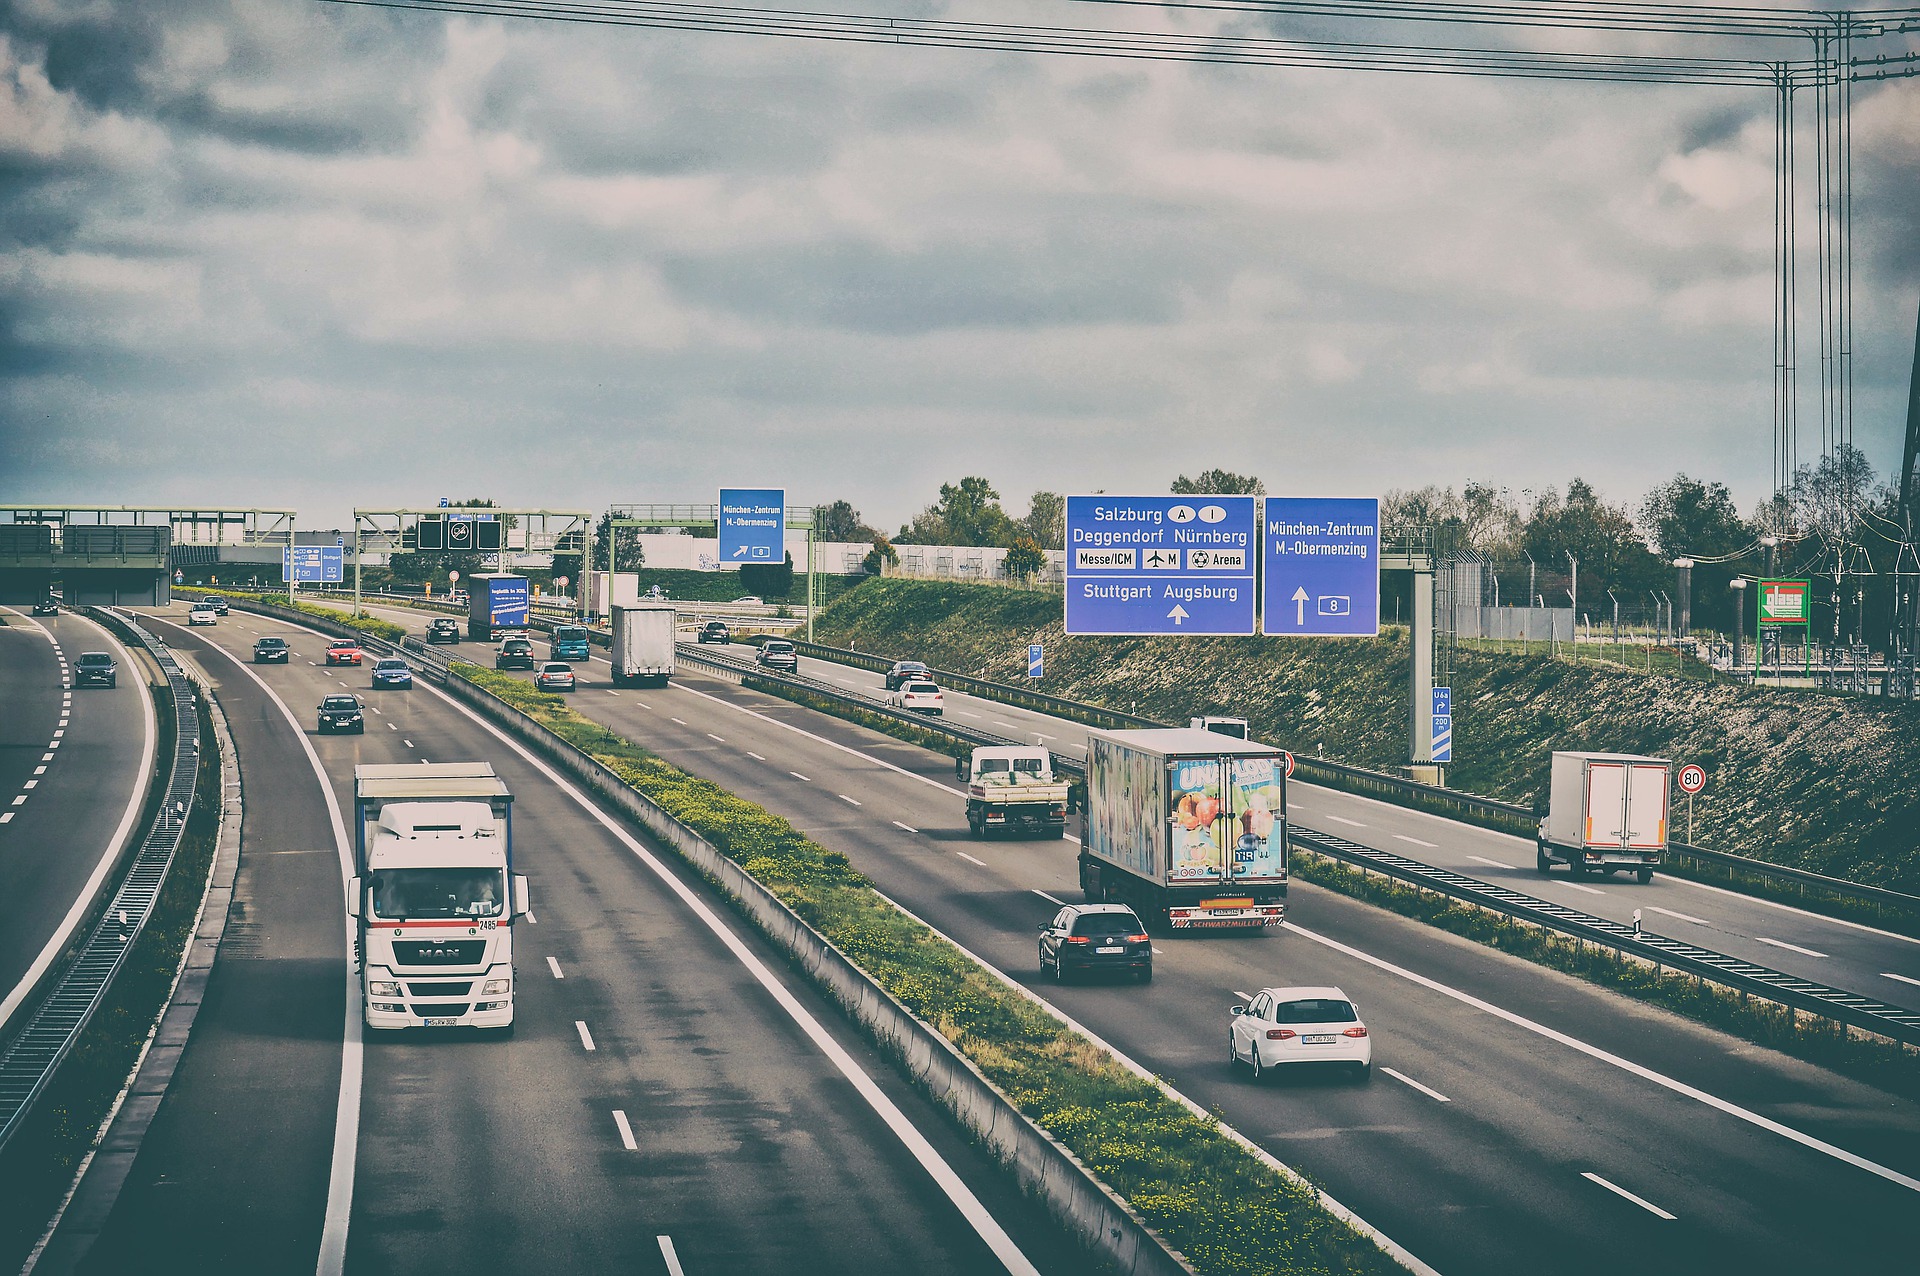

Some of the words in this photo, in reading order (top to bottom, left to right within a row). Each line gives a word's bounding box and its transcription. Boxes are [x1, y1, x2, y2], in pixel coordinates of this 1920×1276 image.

[723, 505, 780, 514] München-Zentrum
[1094, 506, 1163, 524] Salzburg
[1177, 509, 1186, 519] A
[726, 518, 777, 528] M.-Obermenzing
[1269, 521, 1374, 536] München-Zentrum
[1073, 528, 1164, 546] Deggendorf
[1174, 528, 1247, 547] Nürnberg
[1275, 540, 1367, 559] M.-Obermenzing
[1080, 553, 1132, 566] Messe/ICM
[1168, 553, 1177, 565] M
[1213, 553, 1241, 565] Arena
[1083, 583, 1152, 601] Stuttgart
[1163, 584, 1238, 602] Augsburg
[1330, 599, 1338, 612] 8
[1684, 772, 1700, 785] 80
[1235, 851, 1254, 861] TIR
[479, 920, 496, 930] 2485
[419, 949, 460, 958] MAN
